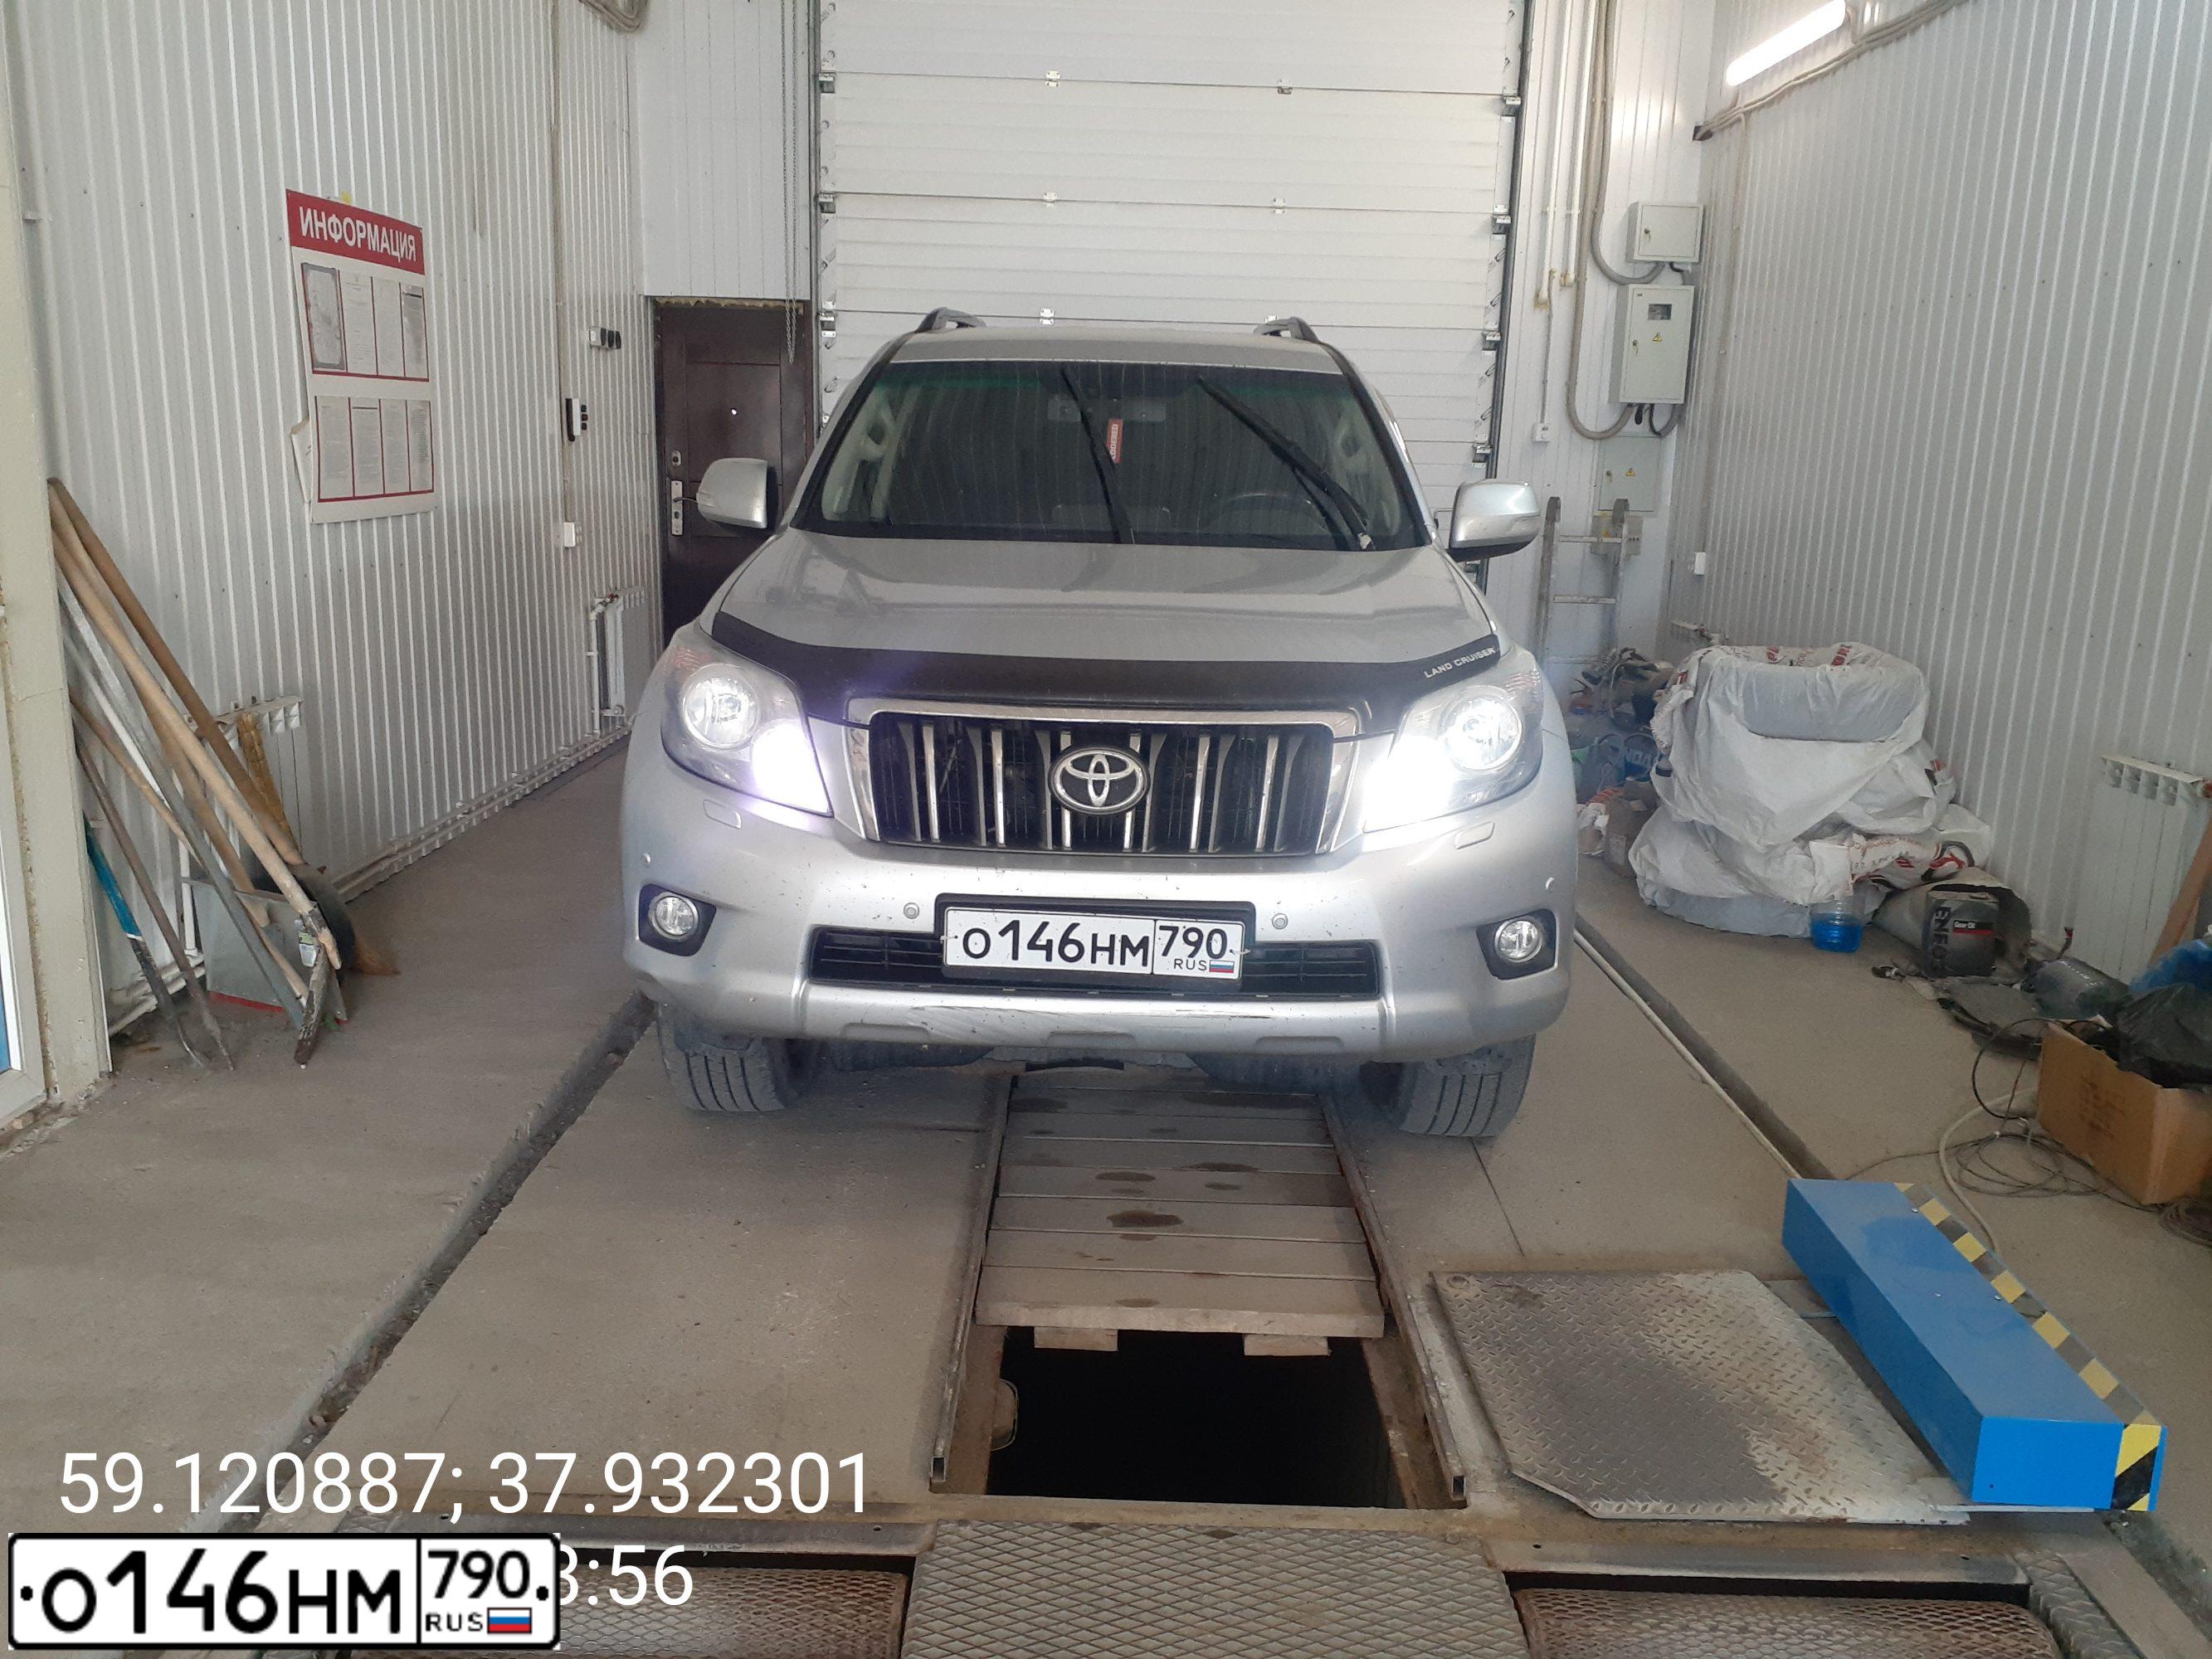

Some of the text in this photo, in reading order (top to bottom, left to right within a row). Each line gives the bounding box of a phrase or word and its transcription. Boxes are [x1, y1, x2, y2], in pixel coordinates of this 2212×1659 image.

[299, 206, 417, 263] ИНФОРМАЦИЯ
[1423, 646, 1496, 679] LAND CRUISER
[1159, 925, 1228, 960] 790
[1173, 958, 1208, 971] RUS
